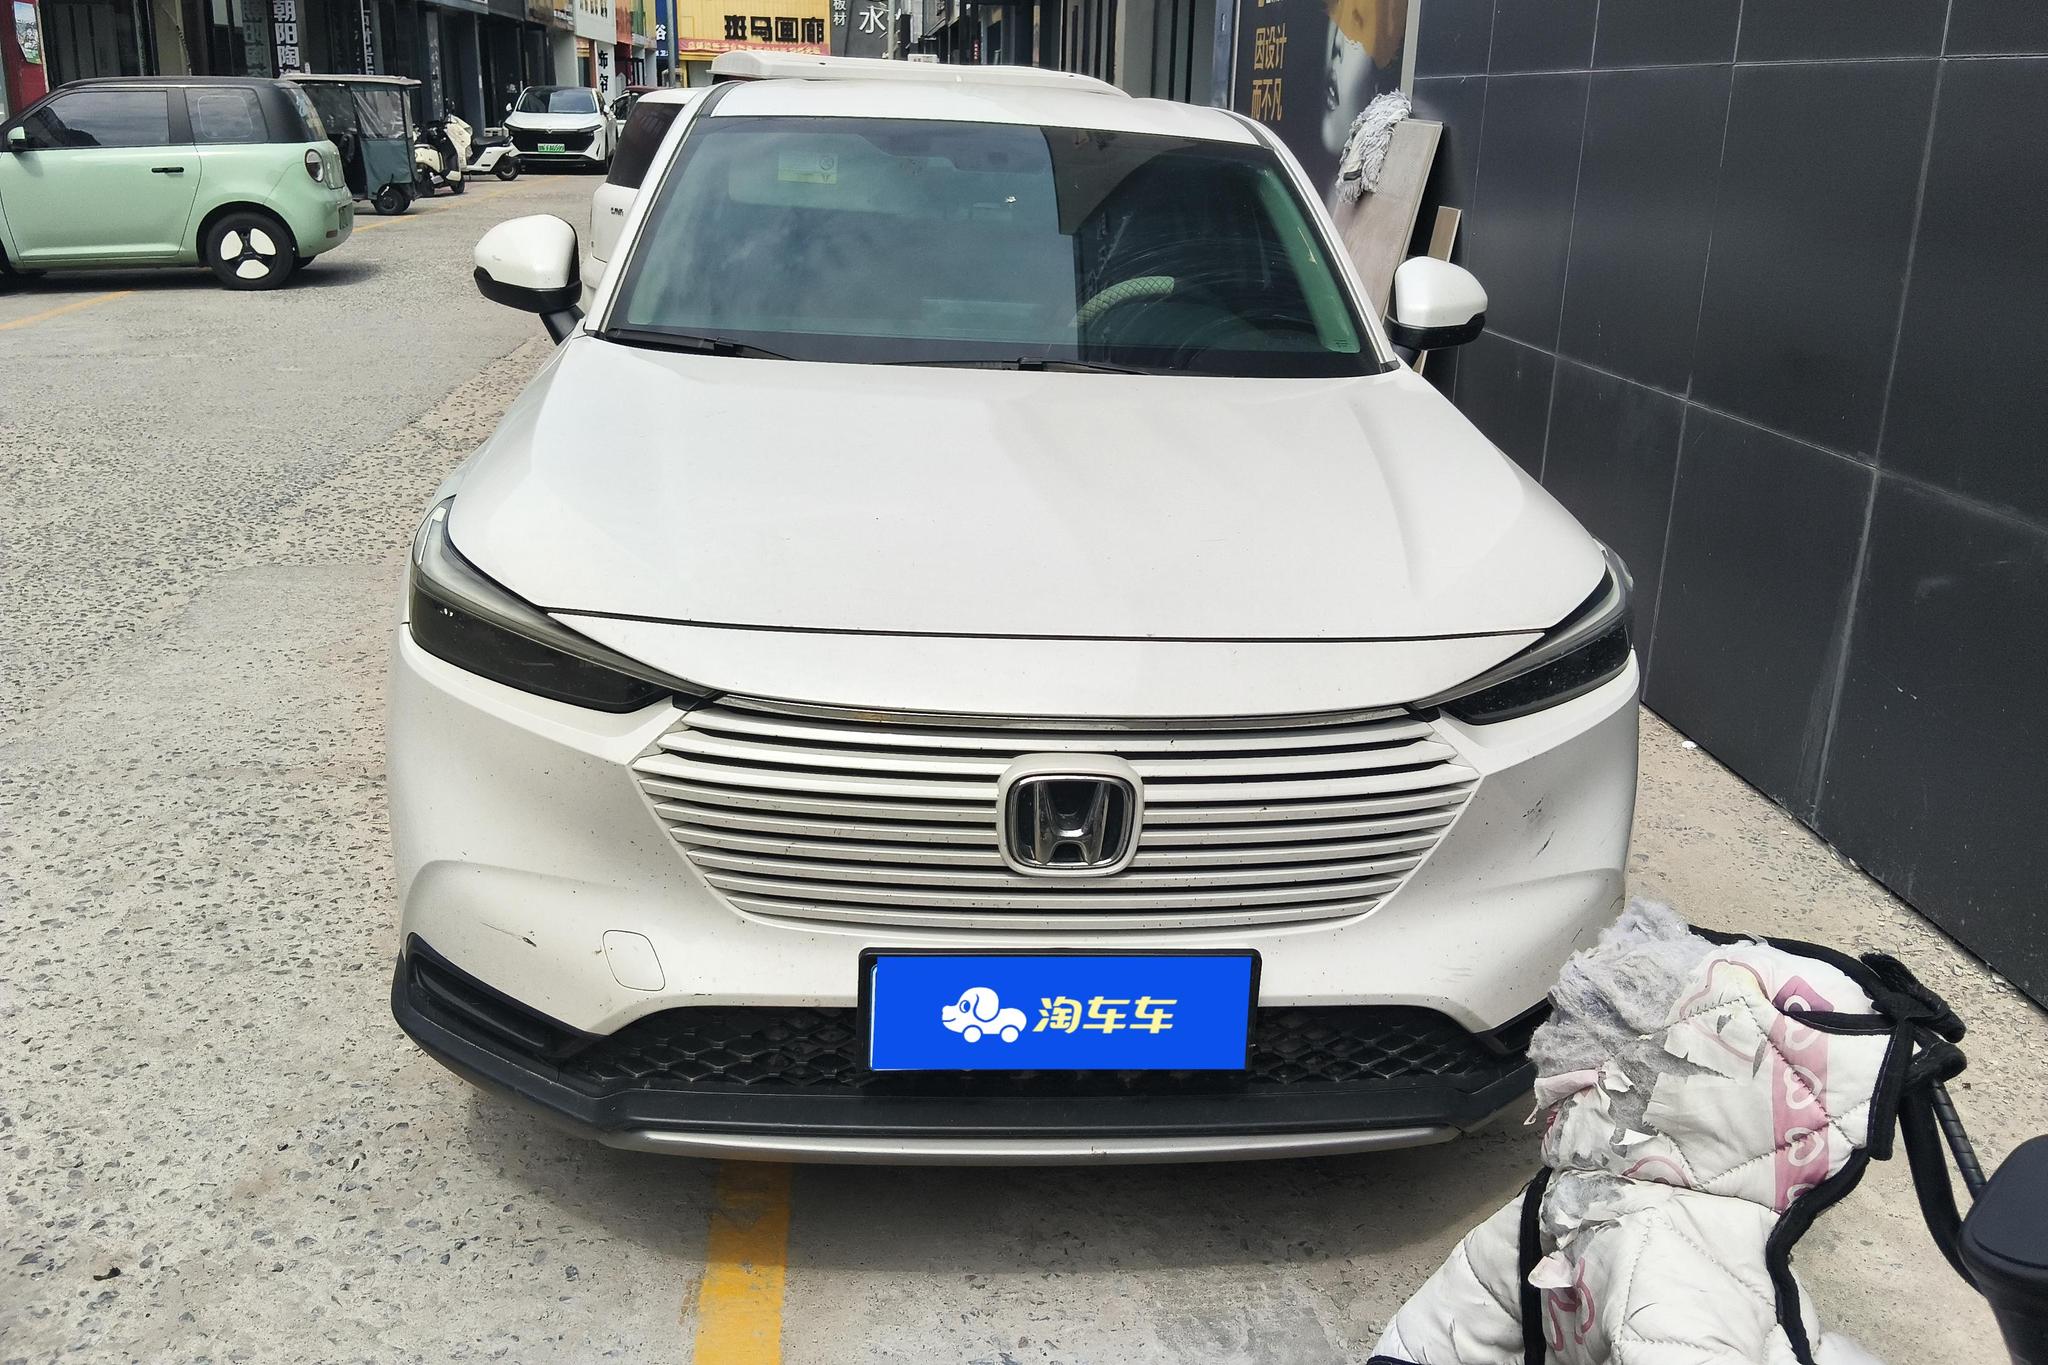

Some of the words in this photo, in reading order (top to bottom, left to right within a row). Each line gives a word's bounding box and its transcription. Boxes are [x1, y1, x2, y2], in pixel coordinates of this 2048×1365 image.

[724, 15, 825, 43] 斑马画廊
[833, 0, 847, 26] 板材
[273, 0, 300, 74] 朝阳陶
[1254, 23, 1287, 70] 因设计
[1251, 78, 1282, 120] 而不凡
